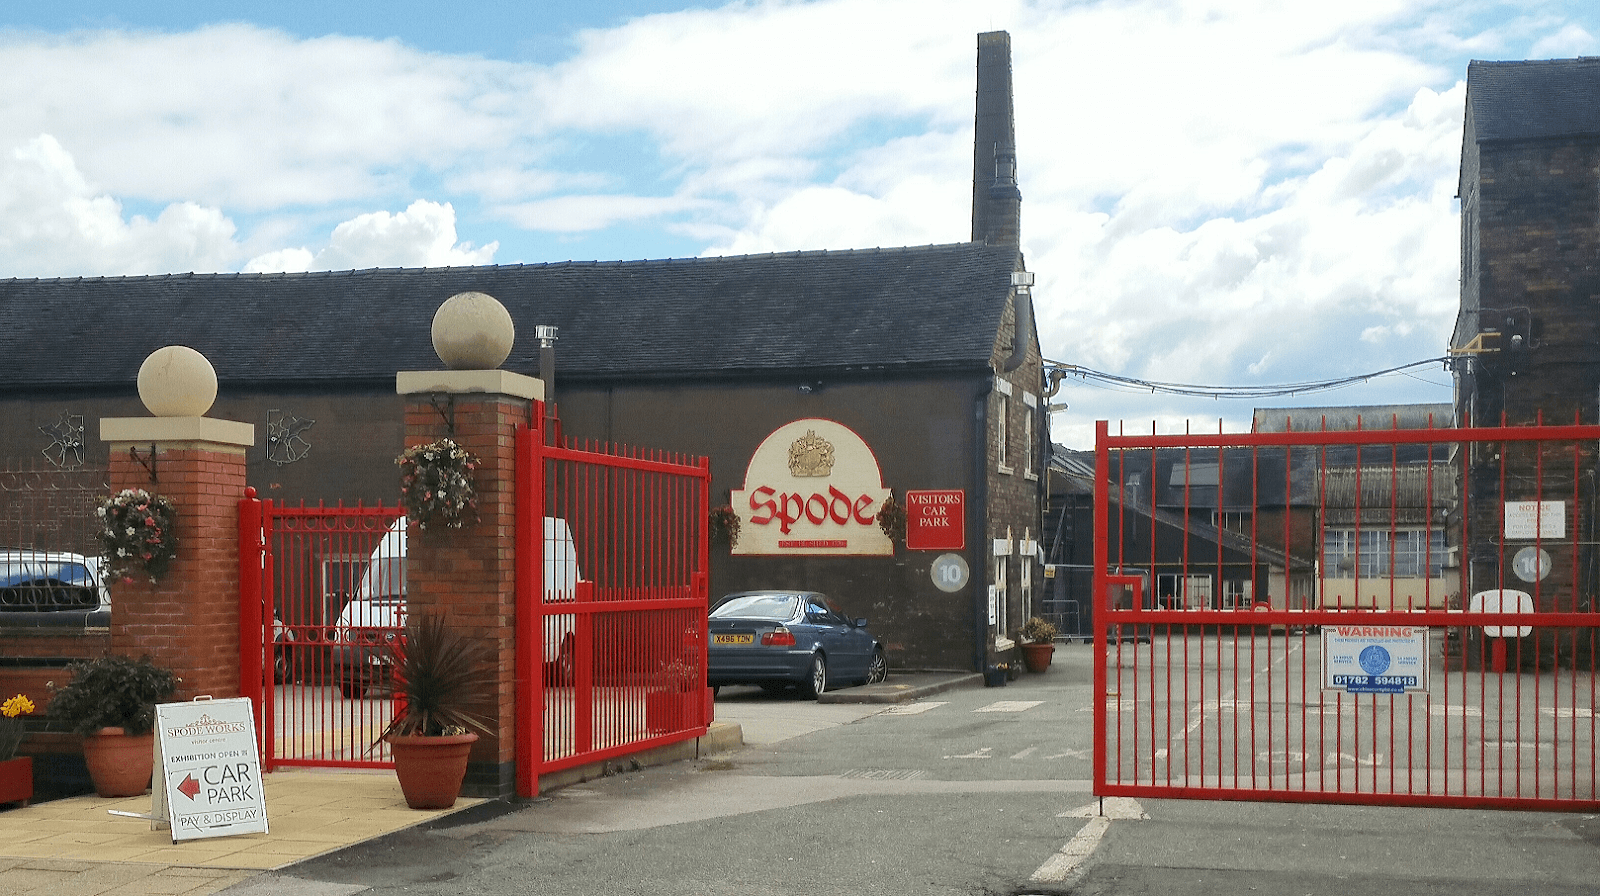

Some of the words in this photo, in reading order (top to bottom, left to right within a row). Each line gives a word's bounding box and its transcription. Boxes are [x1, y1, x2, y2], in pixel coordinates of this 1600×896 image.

[910, 494, 961, 504] VISITORS
[750, 484, 875, 535] Spode
[922, 506, 947, 516] CAR
[919, 517, 950, 527] PARK
[939, 564, 961, 583] 10
[1337, 626, 1412, 638] WARNING
[1335, 676, 1369, 685] 01782
[1374, 676, 1415, 686] 594818
[167, 726, 204, 738] SPODE
[206, 723, 246, 734] WORKS
[171, 752, 216, 763] EXHIBITION
[218, 750, 239, 759] OPEN
[204, 763, 252, 785] CAR
[207, 785, 254, 804] PARK
[180, 815, 201, 827] PAY
[203, 814, 212, 825] &
[214, 809, 257, 823] DISPLAY
